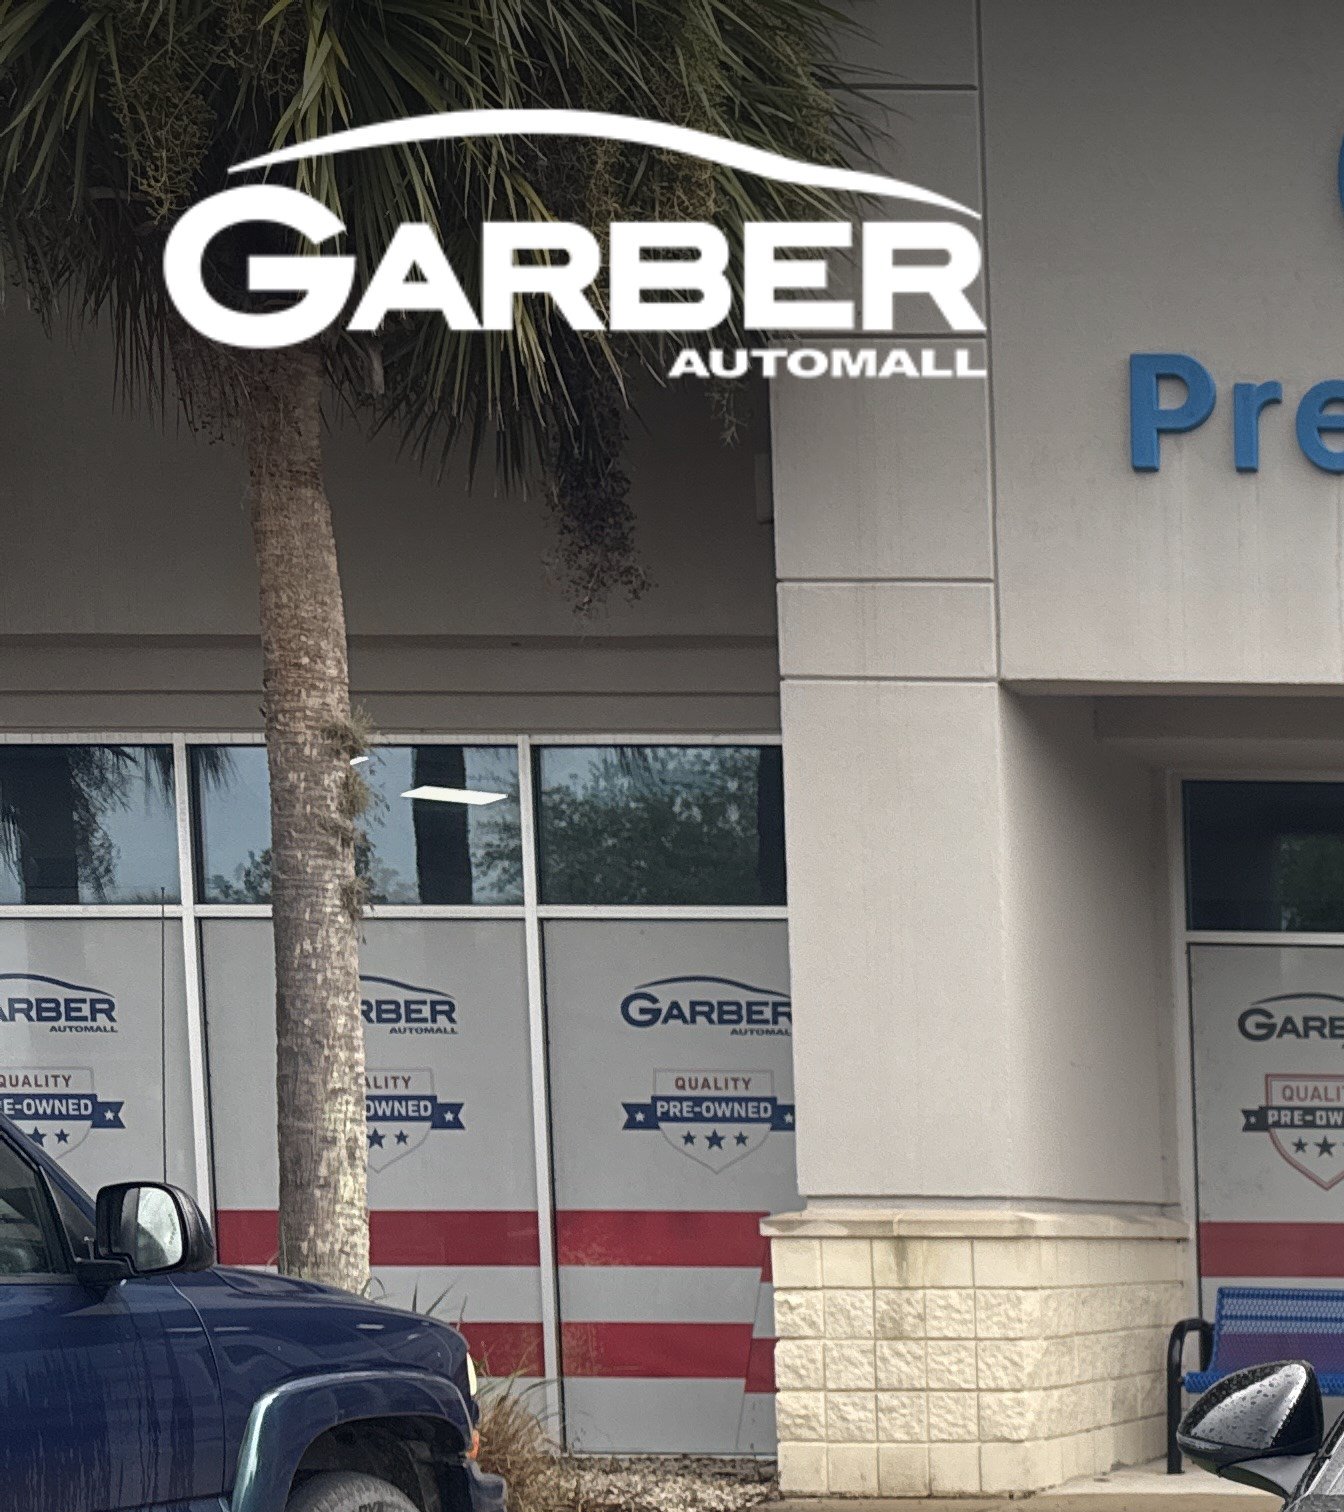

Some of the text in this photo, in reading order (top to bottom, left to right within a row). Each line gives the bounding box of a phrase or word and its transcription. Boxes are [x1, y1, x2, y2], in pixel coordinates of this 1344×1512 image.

[0, 998, 117, 1022] RBER
[621, 992, 793, 1028] GARBER
[49, 1025, 118, 1033] AUTOMALL
[389, 1026, 458, 1035] AUTOMALL
[730, 1028, 792, 1036] AUTOMAL
[674, 1077, 752, 1091] QUALITY
[2, 1098, 93, 1115] E-OWNED
[366, 1100, 432, 1117] OWNED
[656, 1101, 773, 1118] PRE-OWNED
